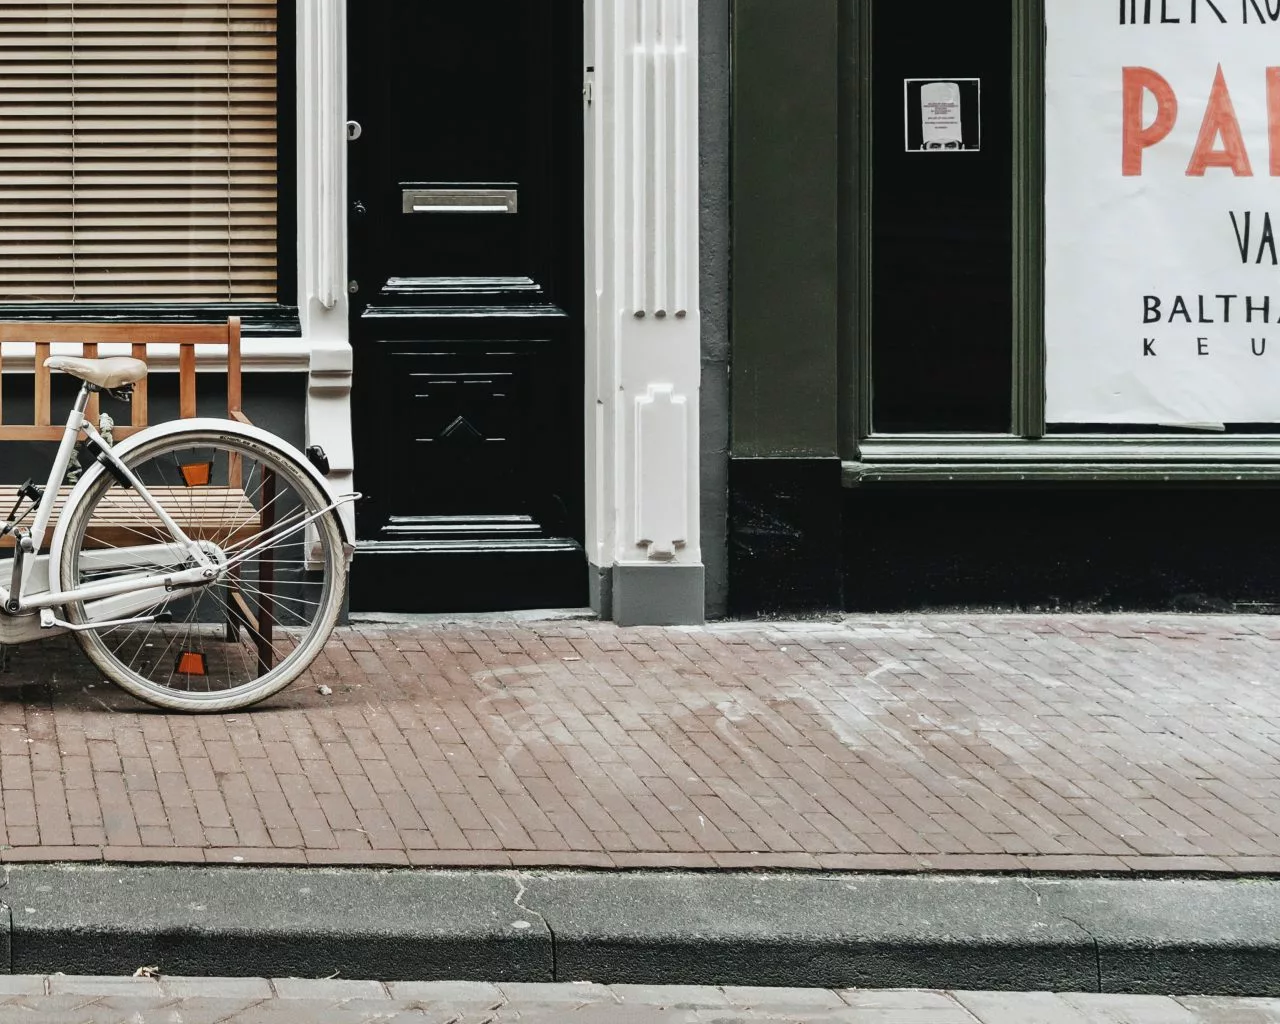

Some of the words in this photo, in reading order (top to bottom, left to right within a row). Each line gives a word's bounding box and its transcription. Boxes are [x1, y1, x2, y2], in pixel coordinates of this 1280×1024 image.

[1122, 61, 1280, 177] PA
[1228, 210, 1278, 266] VA
[1142, 294, 1280, 324] BALTH
